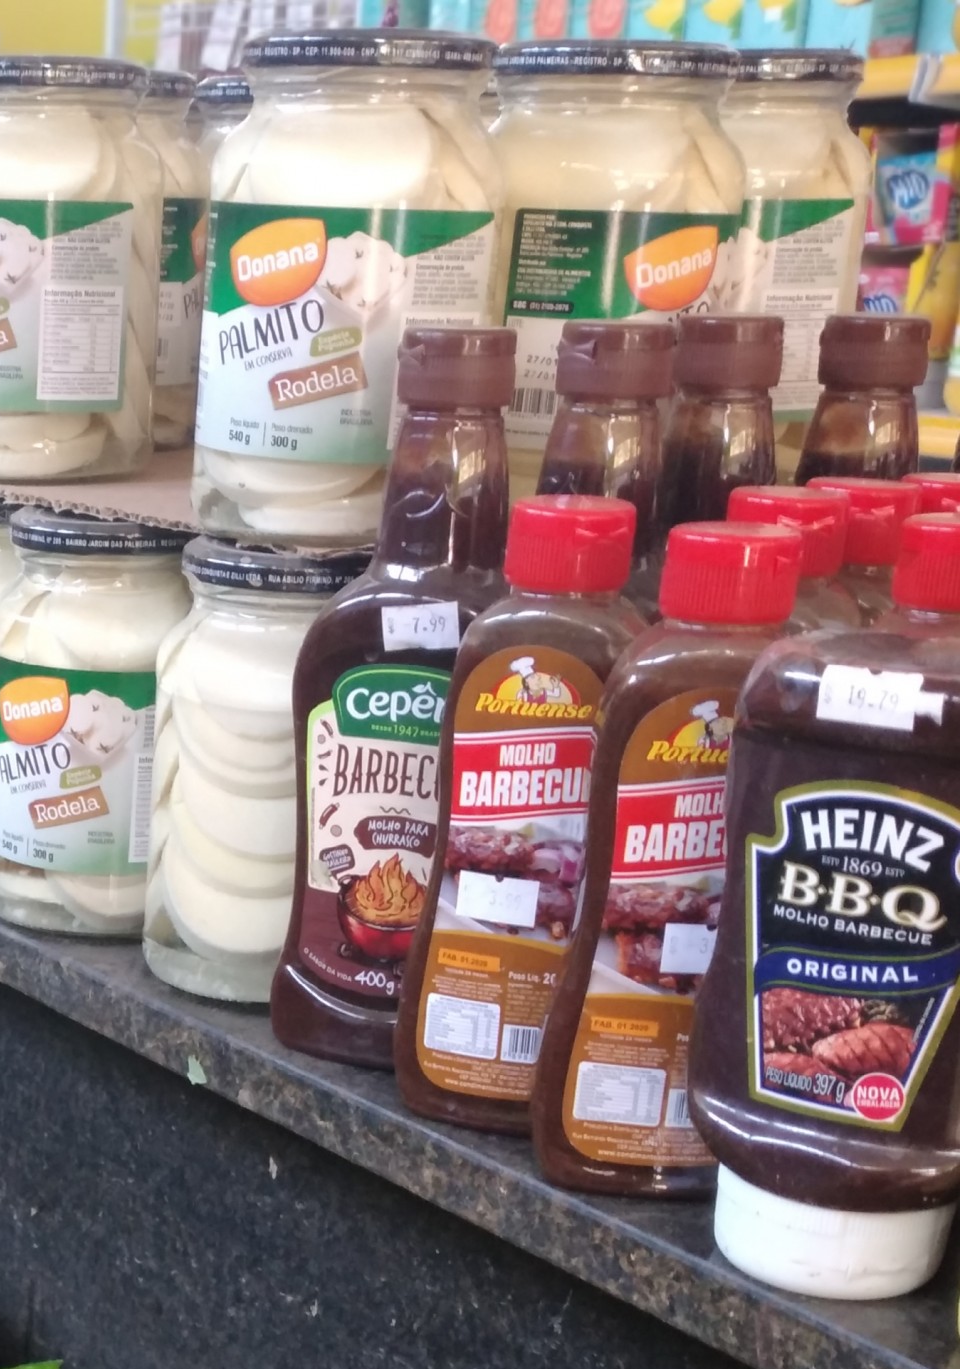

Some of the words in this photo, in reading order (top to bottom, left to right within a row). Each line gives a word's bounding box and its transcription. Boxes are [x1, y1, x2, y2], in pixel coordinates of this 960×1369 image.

[537, 56, 569, 65] PALMEIRAS
[574, 57, 608, 66] REGISTRO
[237, 242, 319, 282] Donana
[636, 248, 712, 289] Donana
[218, 299, 325, 366] PALMITO
[244, 362, 255, 371] EM
[256, 347, 294, 368] CONSERVA
[526, 354, 558, 365] 27/01
[275, 365, 359, 402] Rodela
[523, 370, 556, 381] 27/01
[229, 430, 244, 442] 540
[244, 433, 251, 445] g
[271, 423, 285, 432] Peso
[286, 424, 313, 435] drenado
[271, 435, 289, 447] 300
[291, 439, 298, 450] g
[65, 538, 87, 547] BAIRRO
[87, 540, 109, 548] JARDIM
[111, 540, 123, 548] DAS
[124, 540, 156, 548] PALMEIRAS
[268, 574, 281, 583] RUA
[411, 616, 446, 635] 7.99
[2, 696, 63, 722] Donana
[475, 692, 593, 719] Portuense
[394, 724, 419, 736] 1947
[499, 742, 556, 766] MOLHO
[332, 743, 440, 802] BARBEC
[33, 796, 100, 823] Rodela
[368, 819, 400, 832] MOLHO
[404, 821, 429, 836] PARA
[372, 832, 420, 847] CHURRASCO
[800, 809, 945, 874] HEINZ
[33, 848, 47, 860] 300
[842, 854, 883, 878] 1869
[773, 904, 829, 928] MOLHO
[834, 918, 933, 946] BARBECUE
[308, 952, 327, 970] SABOR
[336, 972, 352, 982] VIDA
[508, 971, 525, 981] Peso
[786, 958, 918, 982] ORIGINAL
[766, 1066, 783, 1085] PESO
[813, 1073, 836, 1097] 397
[836, 1082, 845, 1104] g
[857, 1085, 900, 1101] NOVA
